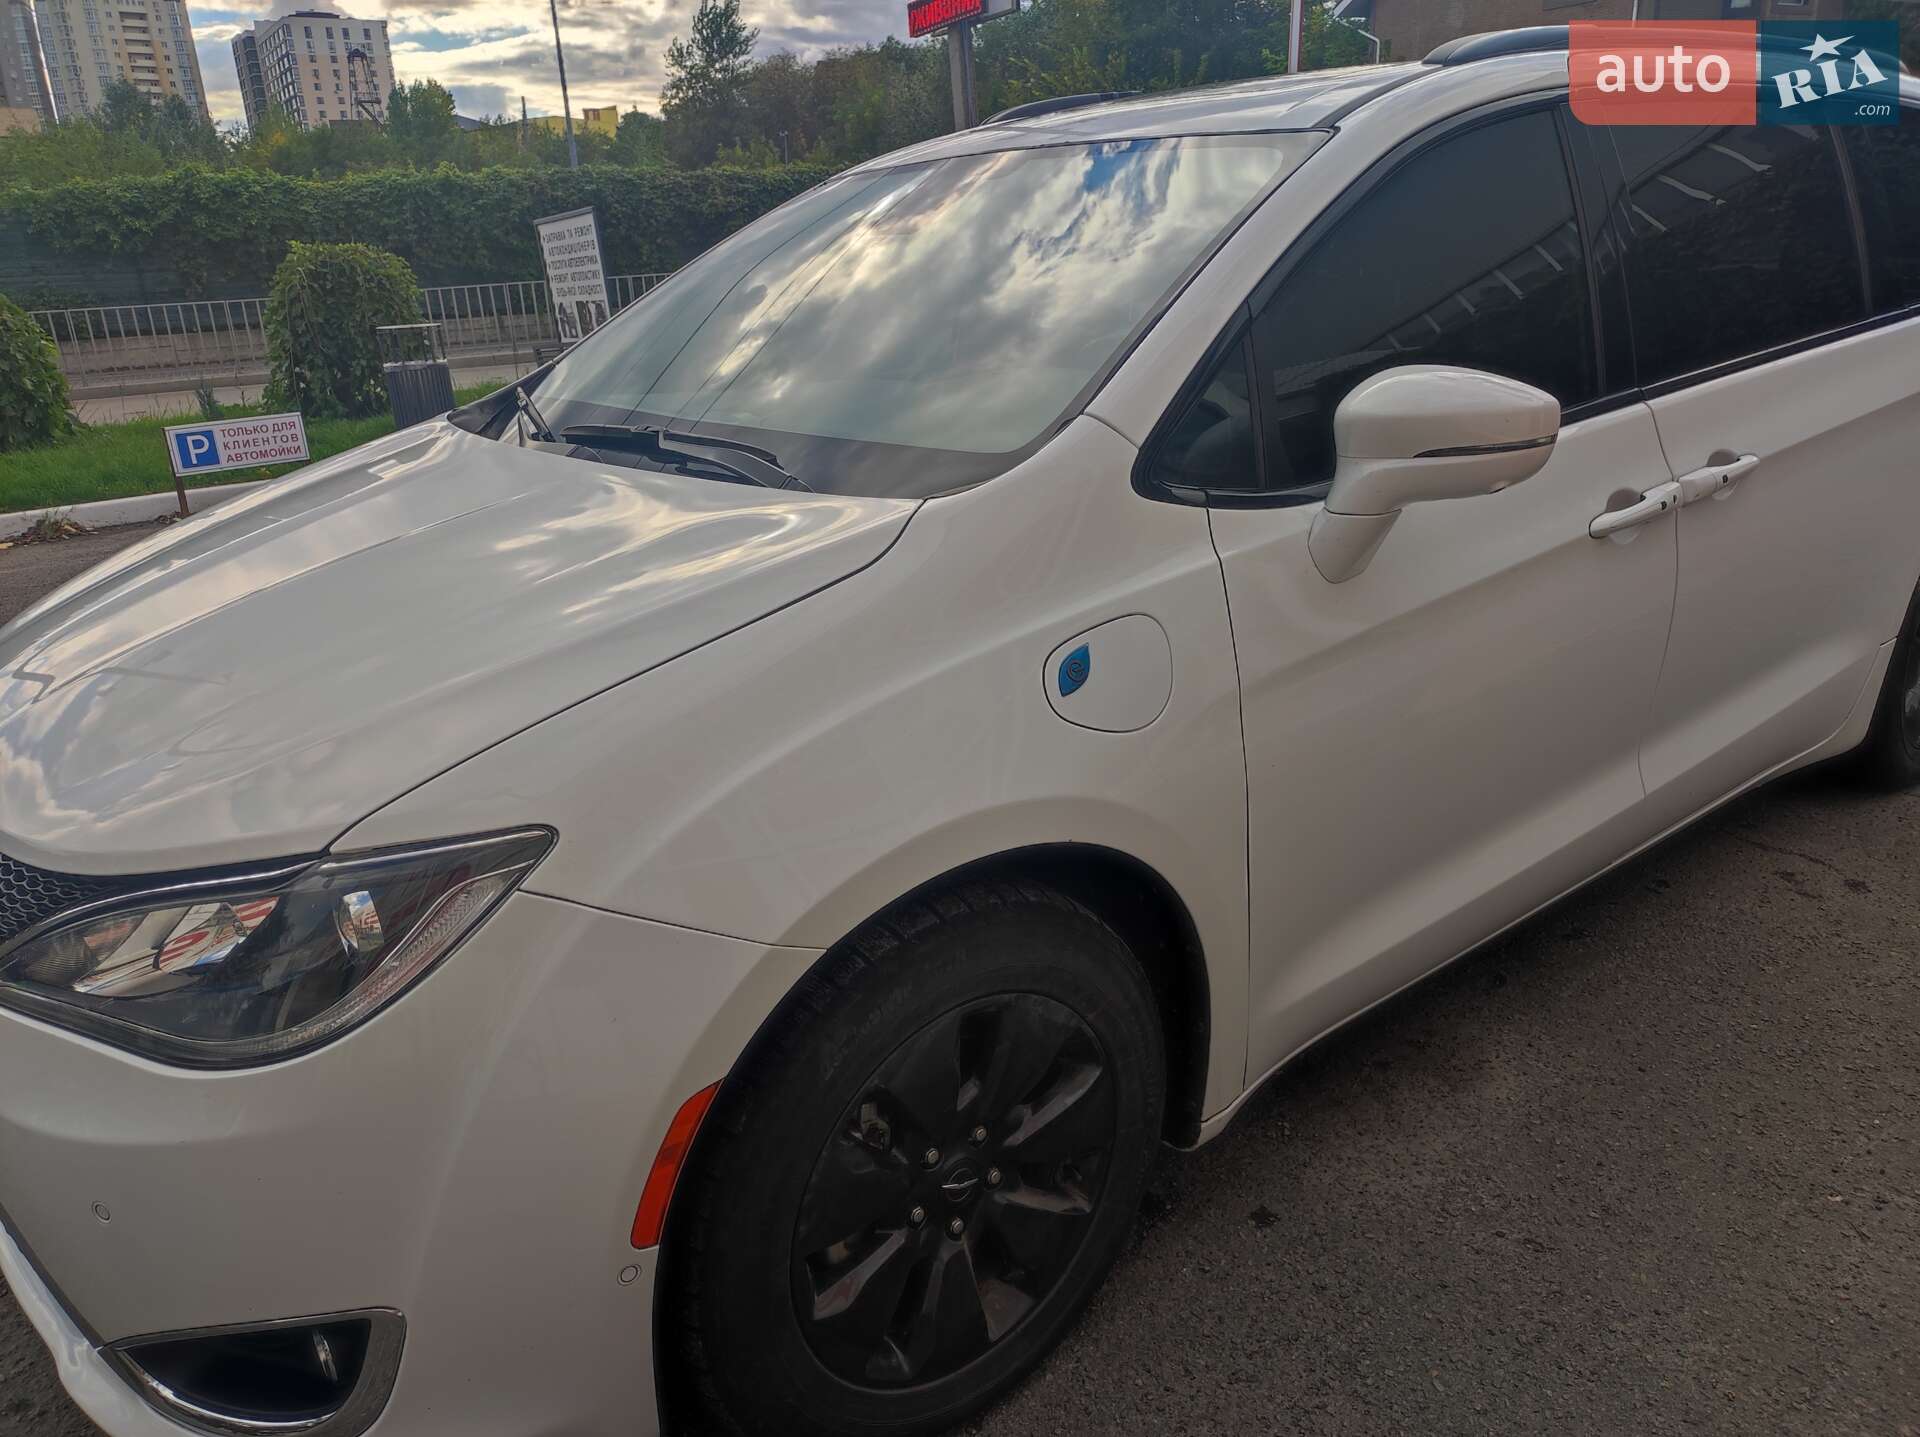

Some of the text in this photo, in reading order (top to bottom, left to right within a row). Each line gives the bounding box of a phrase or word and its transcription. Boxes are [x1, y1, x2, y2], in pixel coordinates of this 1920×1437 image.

[574, 224, 593, 238] РЕМОНТ
[553, 272, 569, 283] РЕМОНТ
[219, 421, 296, 438] ТОЛЬКО ДЛЯ
[186, 434, 209, 465] P
[223, 433, 299, 451] КЛИЕНТОВ
[226, 445, 302, 463] АВТОМОЙКИ
